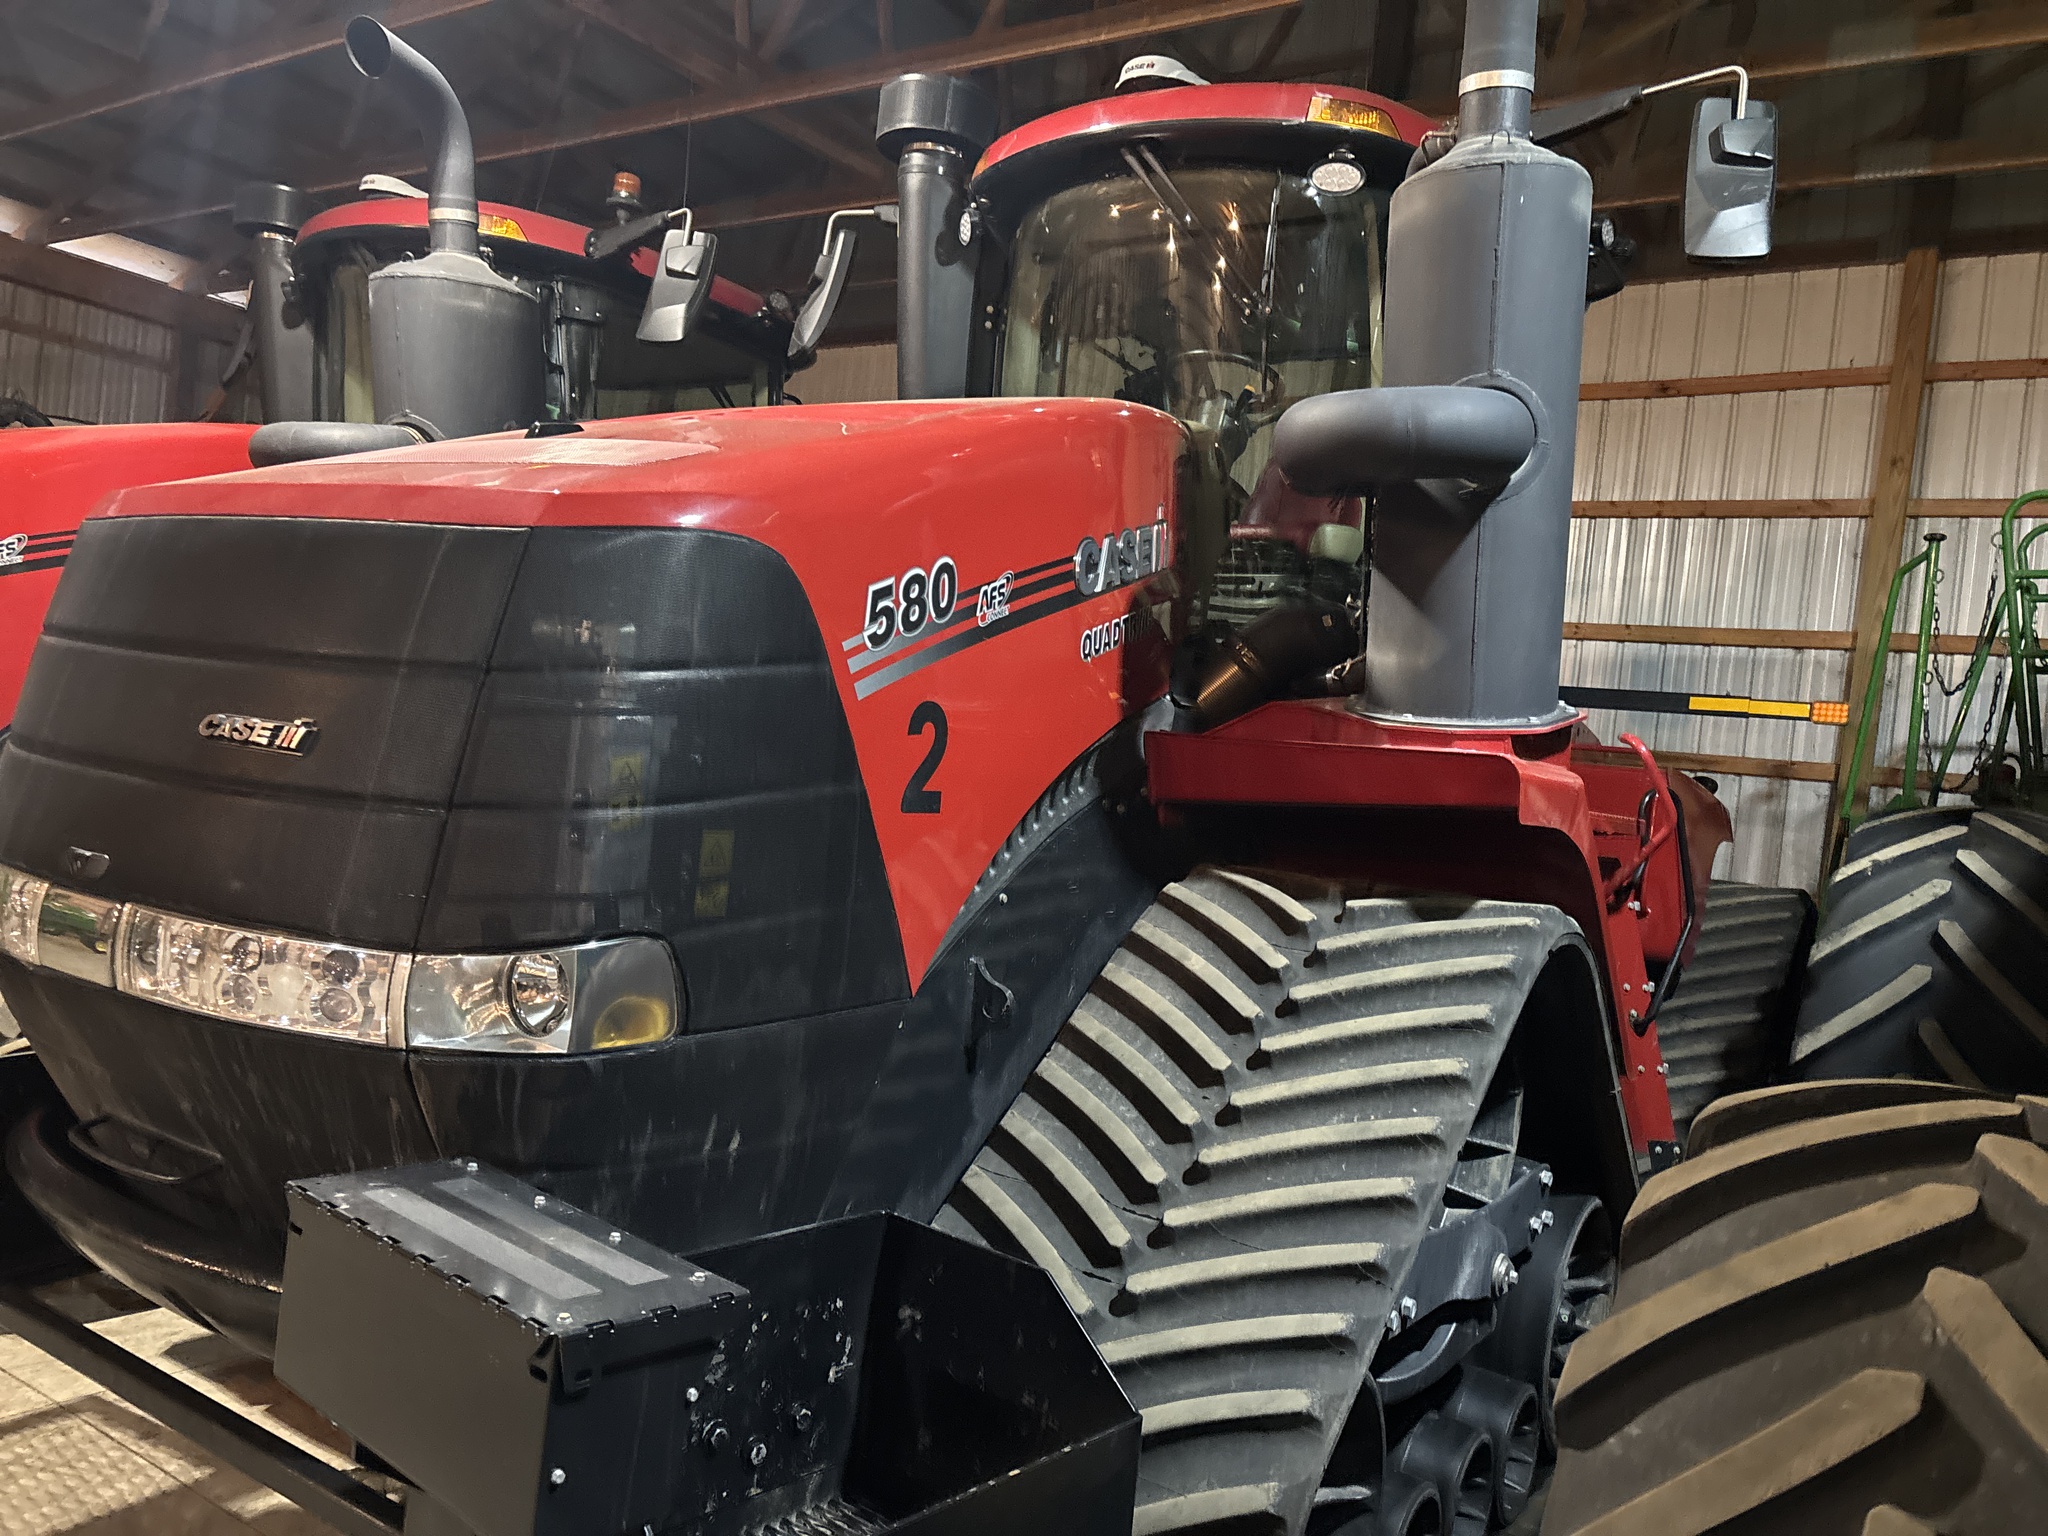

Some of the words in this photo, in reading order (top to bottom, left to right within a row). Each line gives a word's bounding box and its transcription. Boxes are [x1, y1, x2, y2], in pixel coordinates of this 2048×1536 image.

[1125, 63, 1145, 74] CASE
[1073, 525, 1151, 596] CASE
[862, 555, 958, 651] 580
[976, 578, 1007, 617] AFS
[198, 713, 276, 746] CASE
[901, 701, 948, 814] 2
